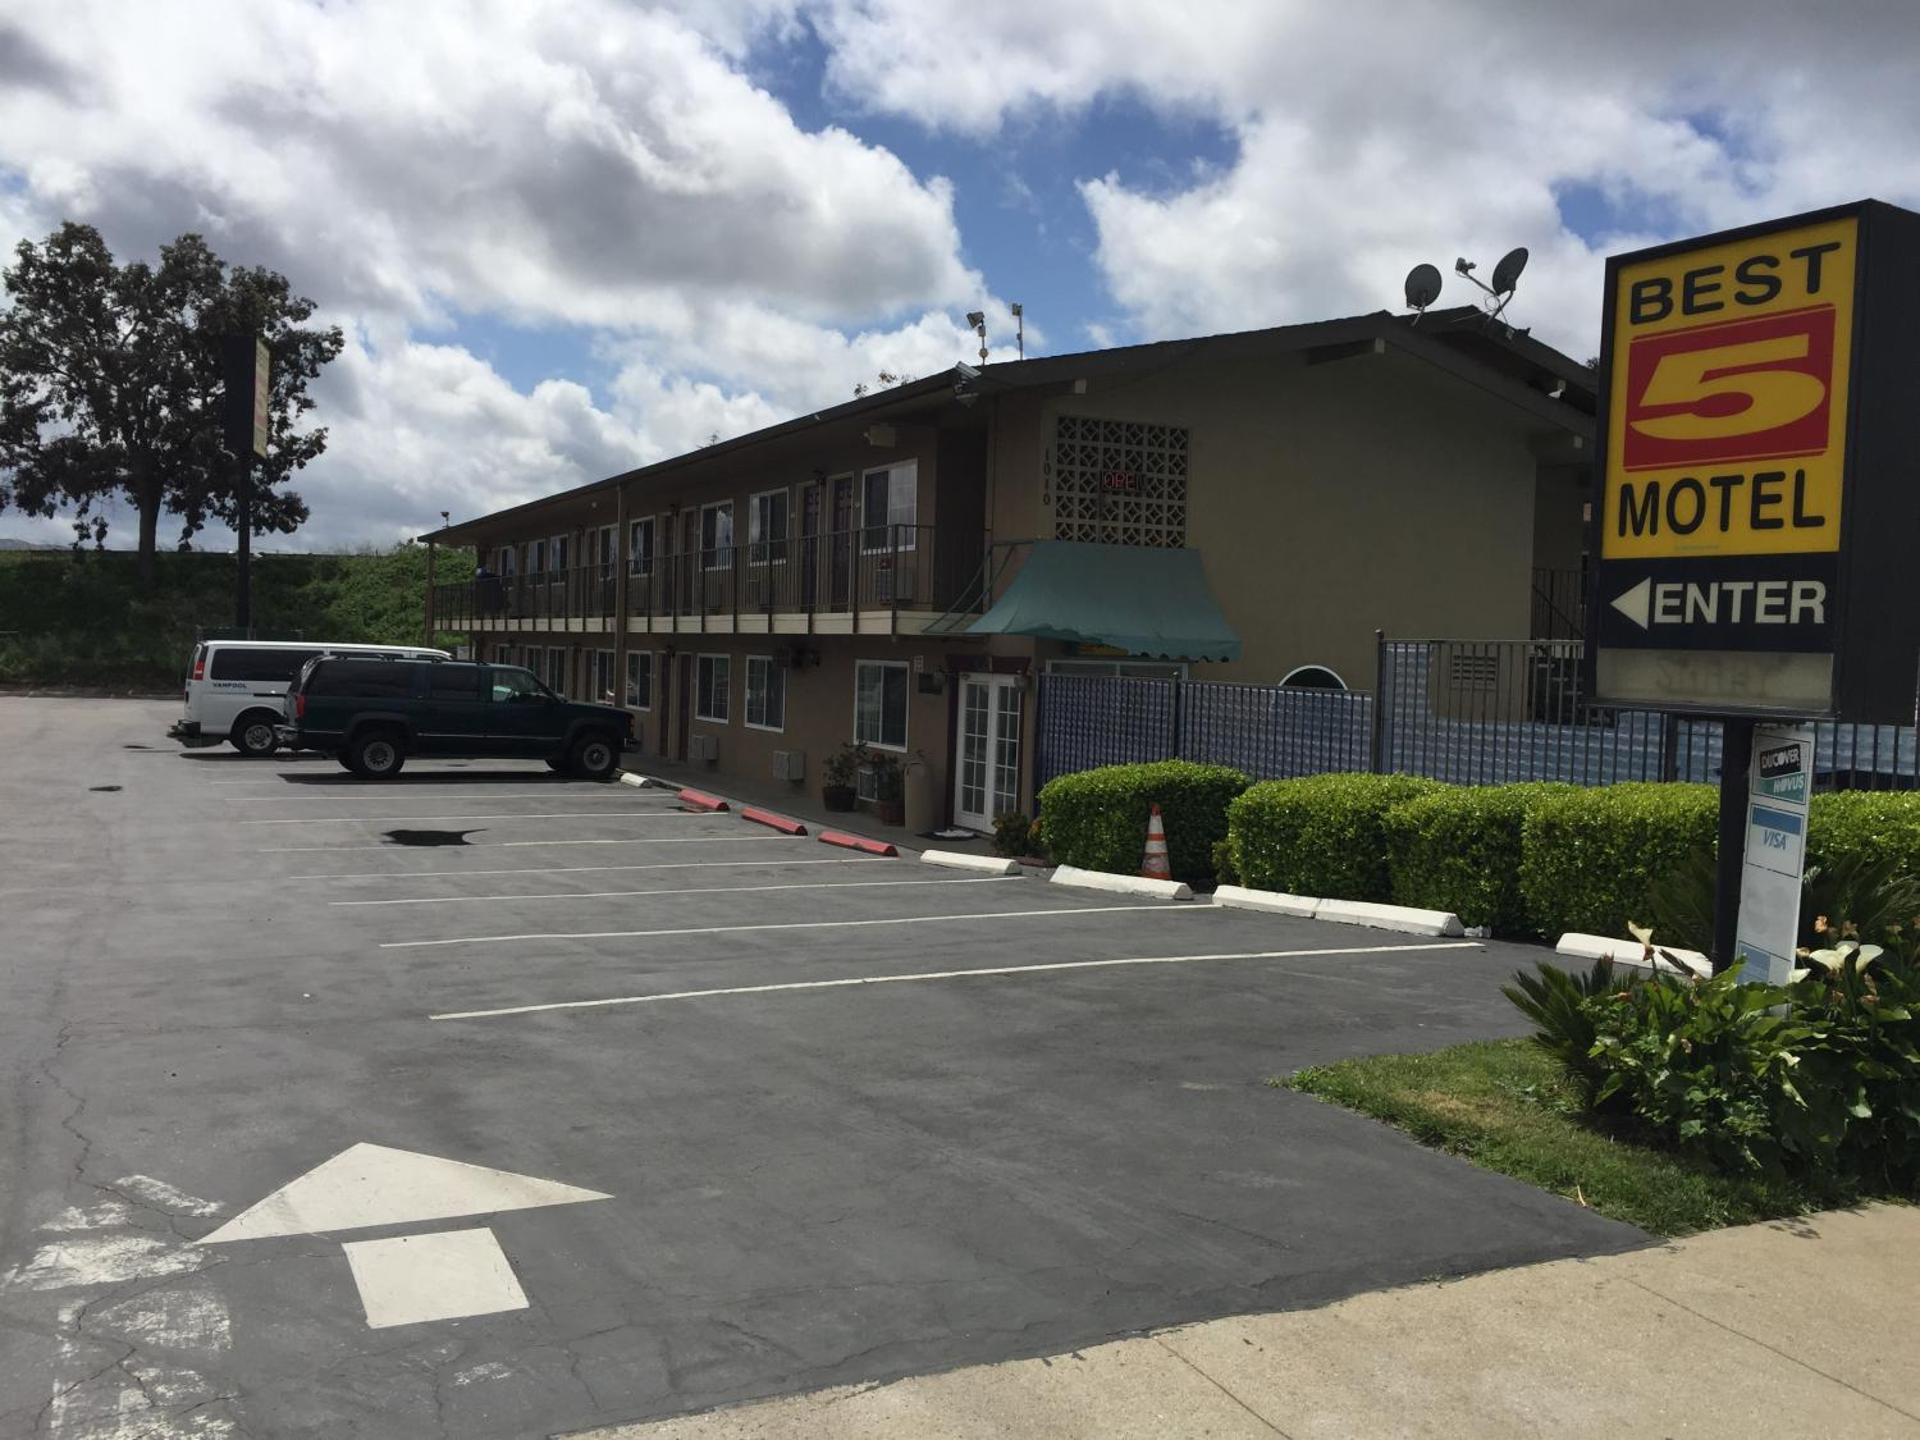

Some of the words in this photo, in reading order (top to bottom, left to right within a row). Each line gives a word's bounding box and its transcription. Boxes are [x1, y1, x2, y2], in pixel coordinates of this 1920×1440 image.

[1629, 241, 1842, 326] BEST
[1629, 333, 1826, 440] 5
[1618, 469, 1826, 537] MOTEL
[1654, 580, 1827, 625] ENTER
[1773, 775, 1804, 793] NOVUS
[1763, 830, 1787, 850] VISA
